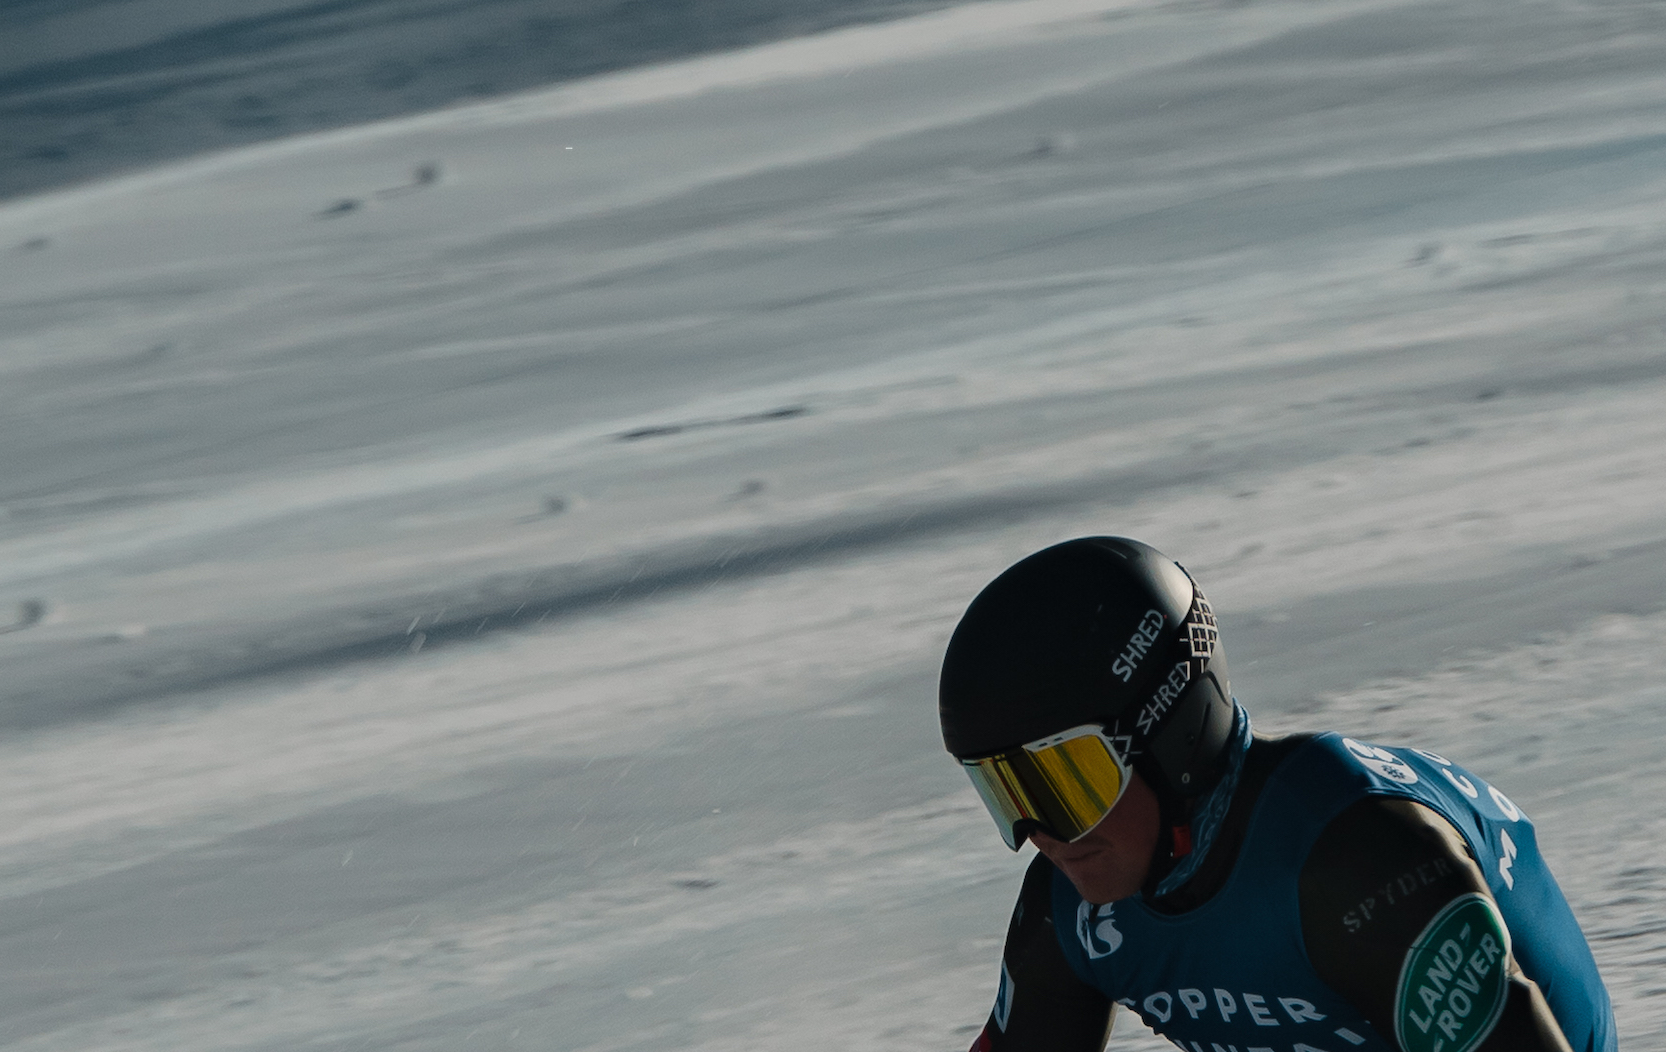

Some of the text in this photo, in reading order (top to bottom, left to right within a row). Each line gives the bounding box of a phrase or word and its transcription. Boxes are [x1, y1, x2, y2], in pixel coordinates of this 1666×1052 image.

[1112, 609, 1165, 682] SHRED
[1136, 661, 1191, 735] SHRED
[1343, 858, 1452, 932] SPYDER
[1408, 938, 1464, 1034] LAND
[1436, 933, 1501, 1042] ROVER
